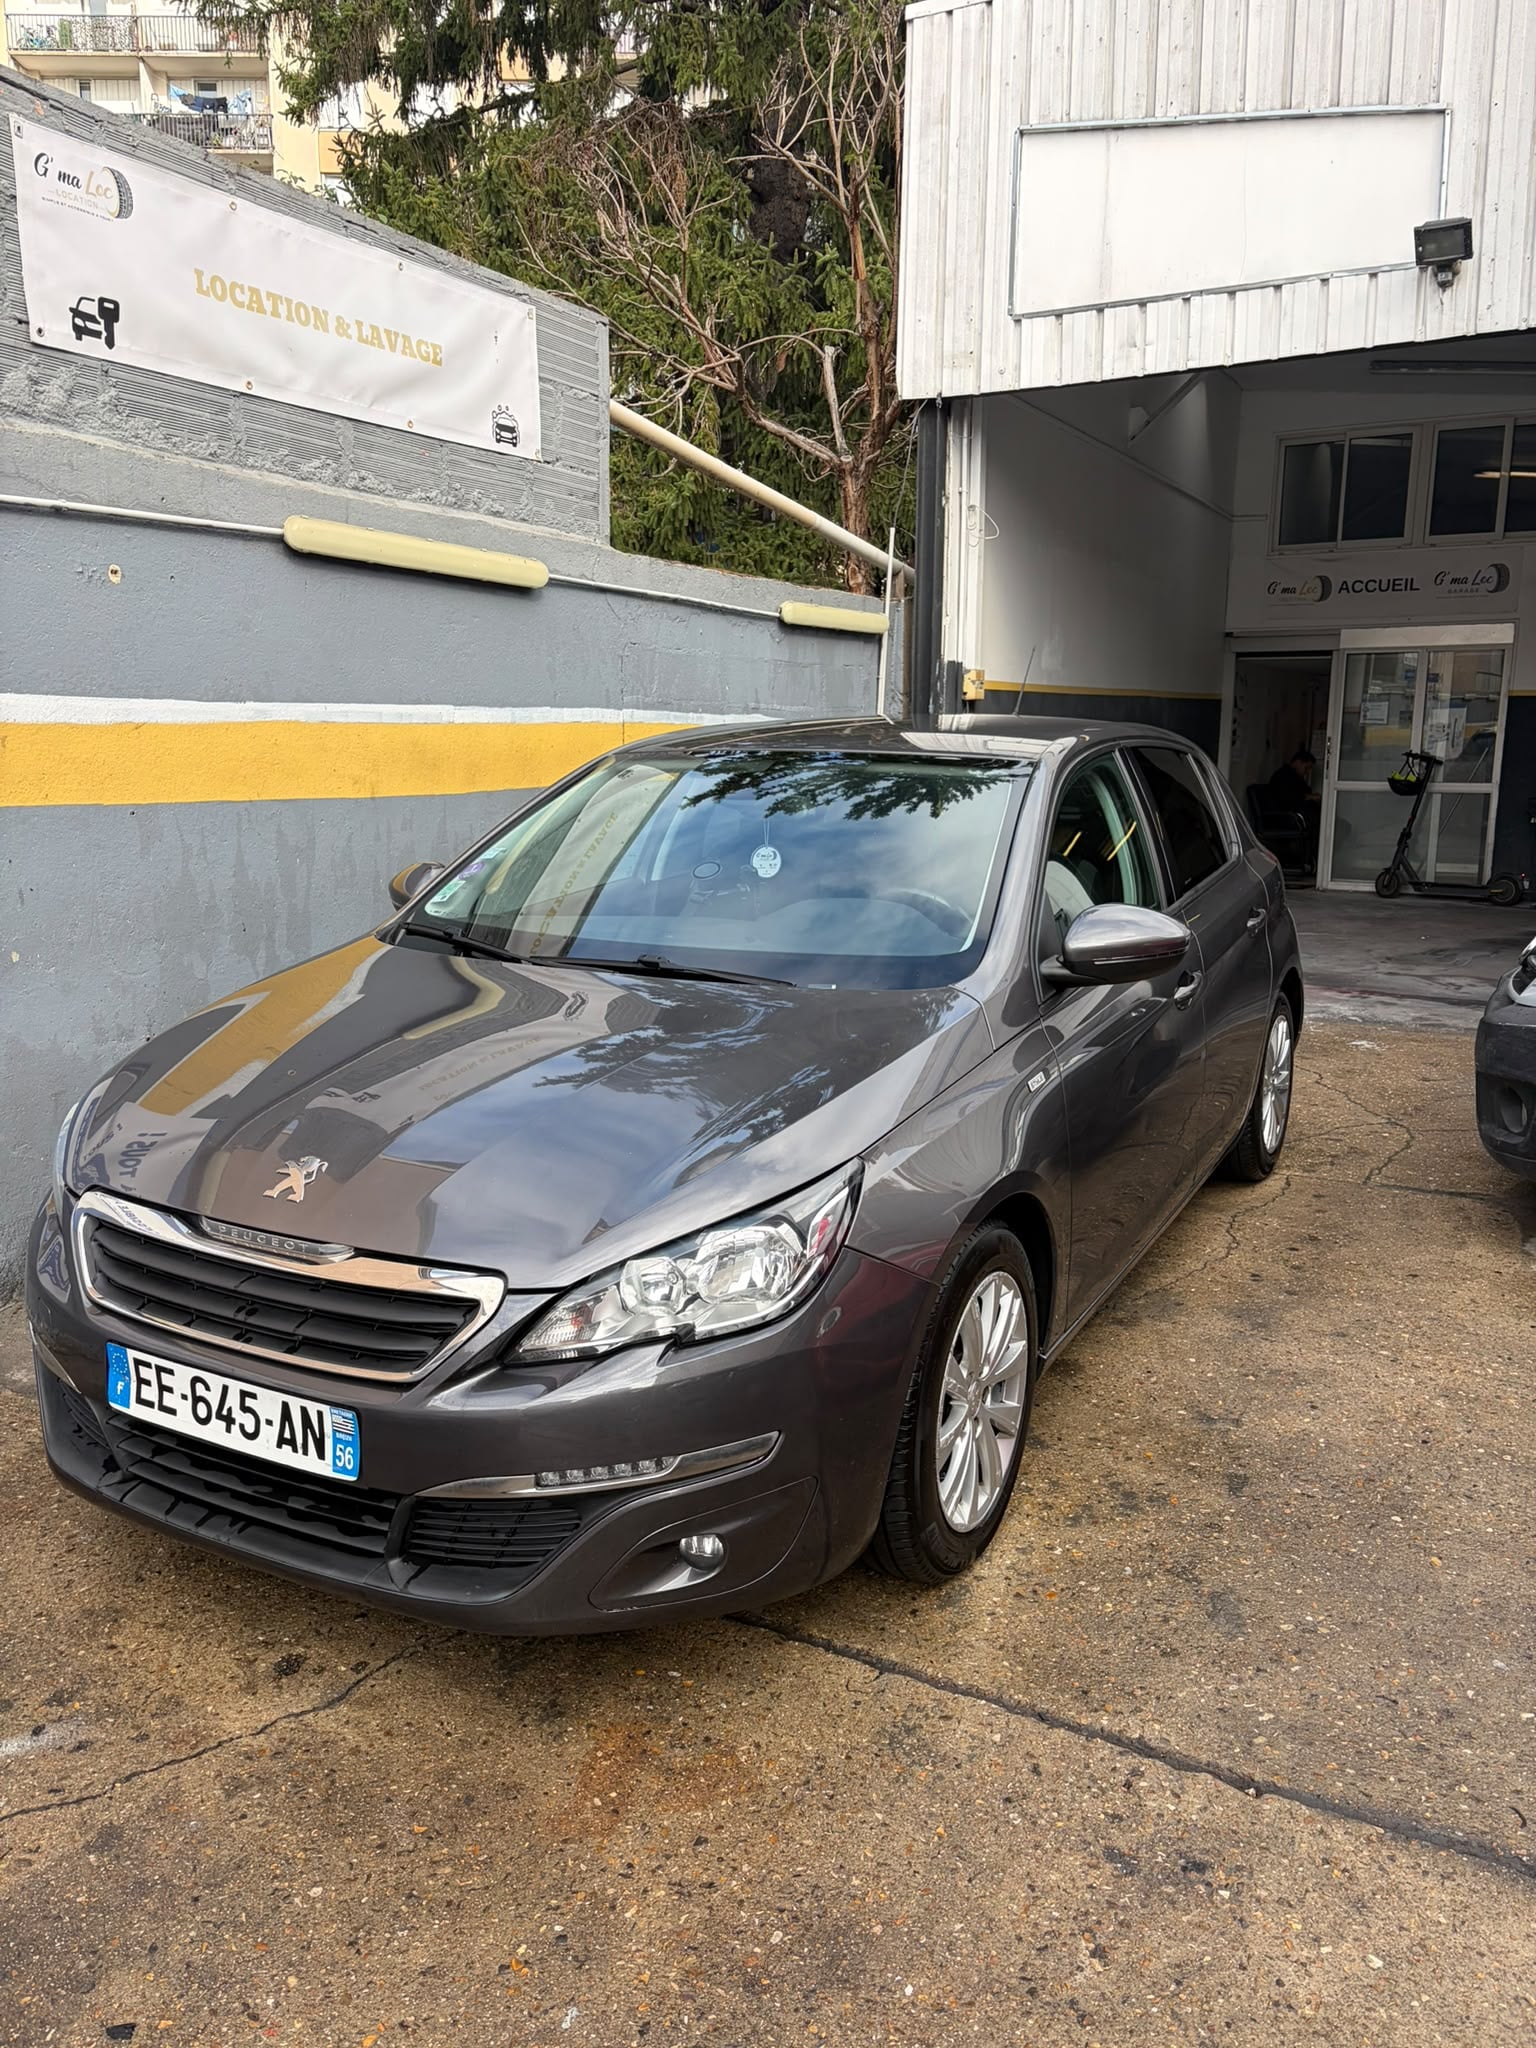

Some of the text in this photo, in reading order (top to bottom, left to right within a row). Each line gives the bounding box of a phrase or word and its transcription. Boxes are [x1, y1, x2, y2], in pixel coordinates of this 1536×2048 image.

[58, 170, 82, 189] ma
[85, 170, 113, 199] Loc
[55, 188, 99, 209] LOCATION
[193, 267, 443, 367] LOCATION & LAVAGE
[1281, 586, 1297, 595] ma
[1338, 577, 1421, 594] ACCUEIL
[1450, 575, 1469, 585] ma
[217, 1224, 310, 1254] PEUGEOT
[116, 1381, 124, 1396] F
[132, 1356, 327, 1461] EE-645-AN
[335, 1443, 354, 1470] 56
